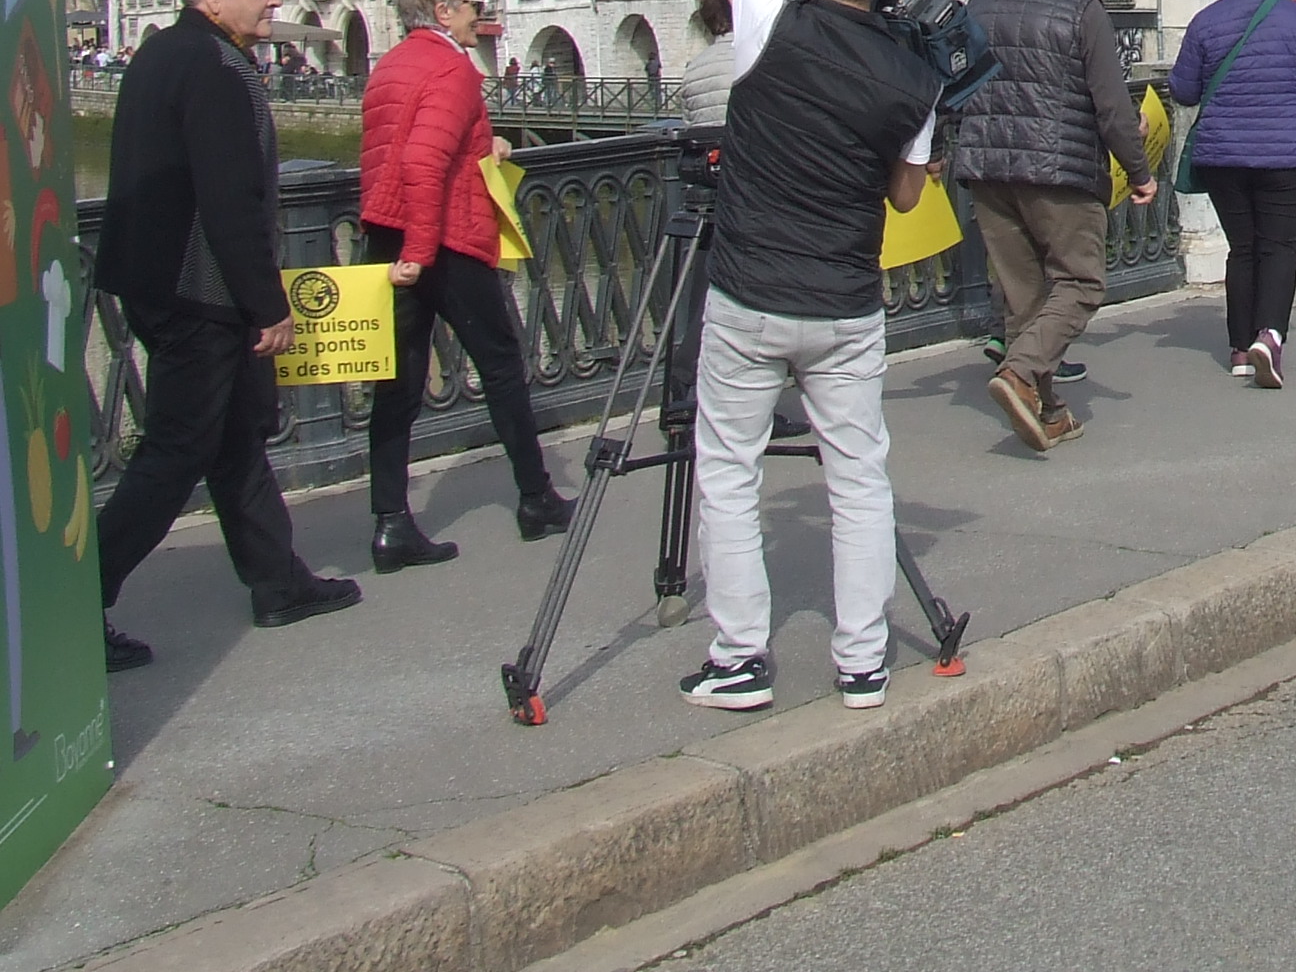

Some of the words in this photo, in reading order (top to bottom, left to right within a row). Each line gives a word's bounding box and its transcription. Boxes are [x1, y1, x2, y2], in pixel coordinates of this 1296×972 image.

[294, 317, 380, 335] struisons
[281, 341, 308, 356] es
[315, 337, 366, 356] ponts
[297, 361, 331, 377] des
[337, 359, 380, 375] murs
[384, 356, 389, 371] !
